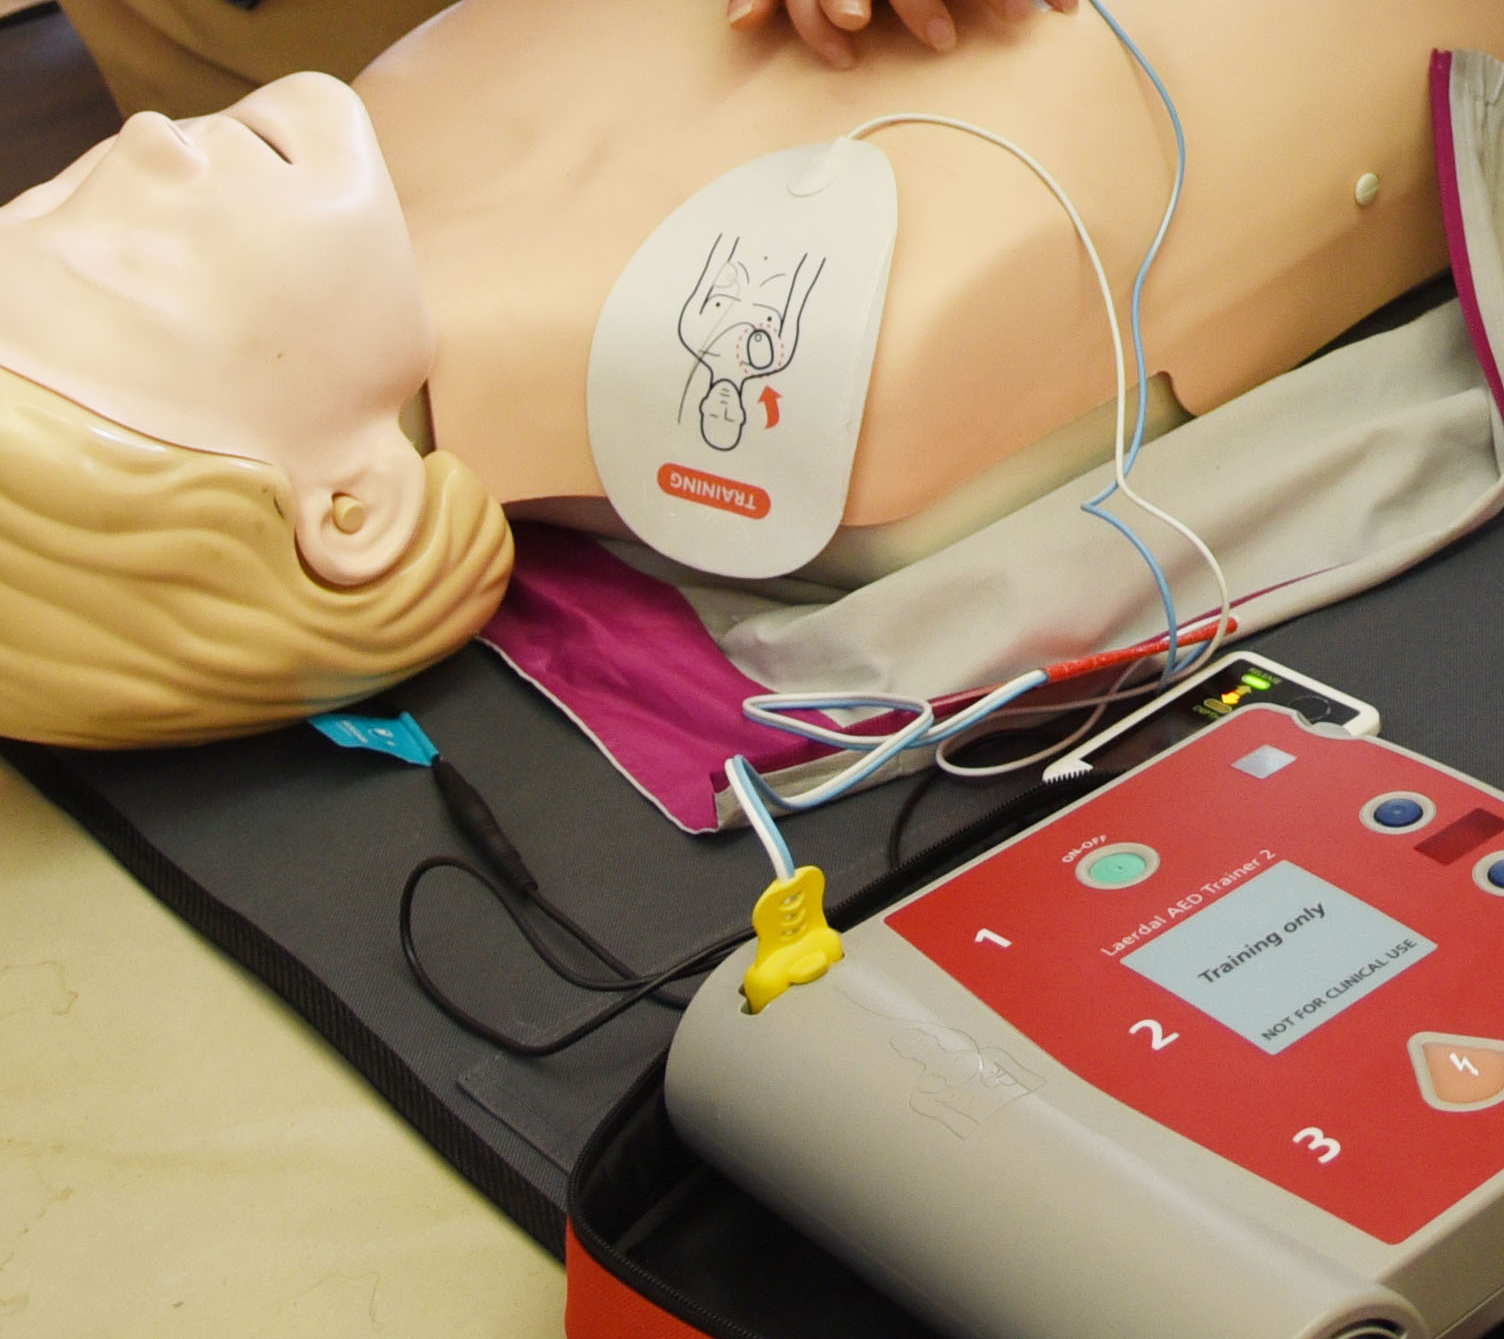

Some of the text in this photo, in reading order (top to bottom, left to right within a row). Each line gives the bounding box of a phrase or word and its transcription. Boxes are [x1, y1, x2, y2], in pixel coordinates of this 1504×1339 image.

[669, 471, 757, 511] TRAINING
[1061, 834, 1108, 864] ON-OFF
[1101, 848, 1276, 957] Laerdal AED Trainer 2
[974, 927, 1012, 949] 1
[1198, 902, 1326, 984] Training only
[1261, 938, 1418, 1052] NOT FOR CLINICAL USE
[1129, 1018, 1180, 1051] 2
[1292, 1126, 1342, 1164] 3
